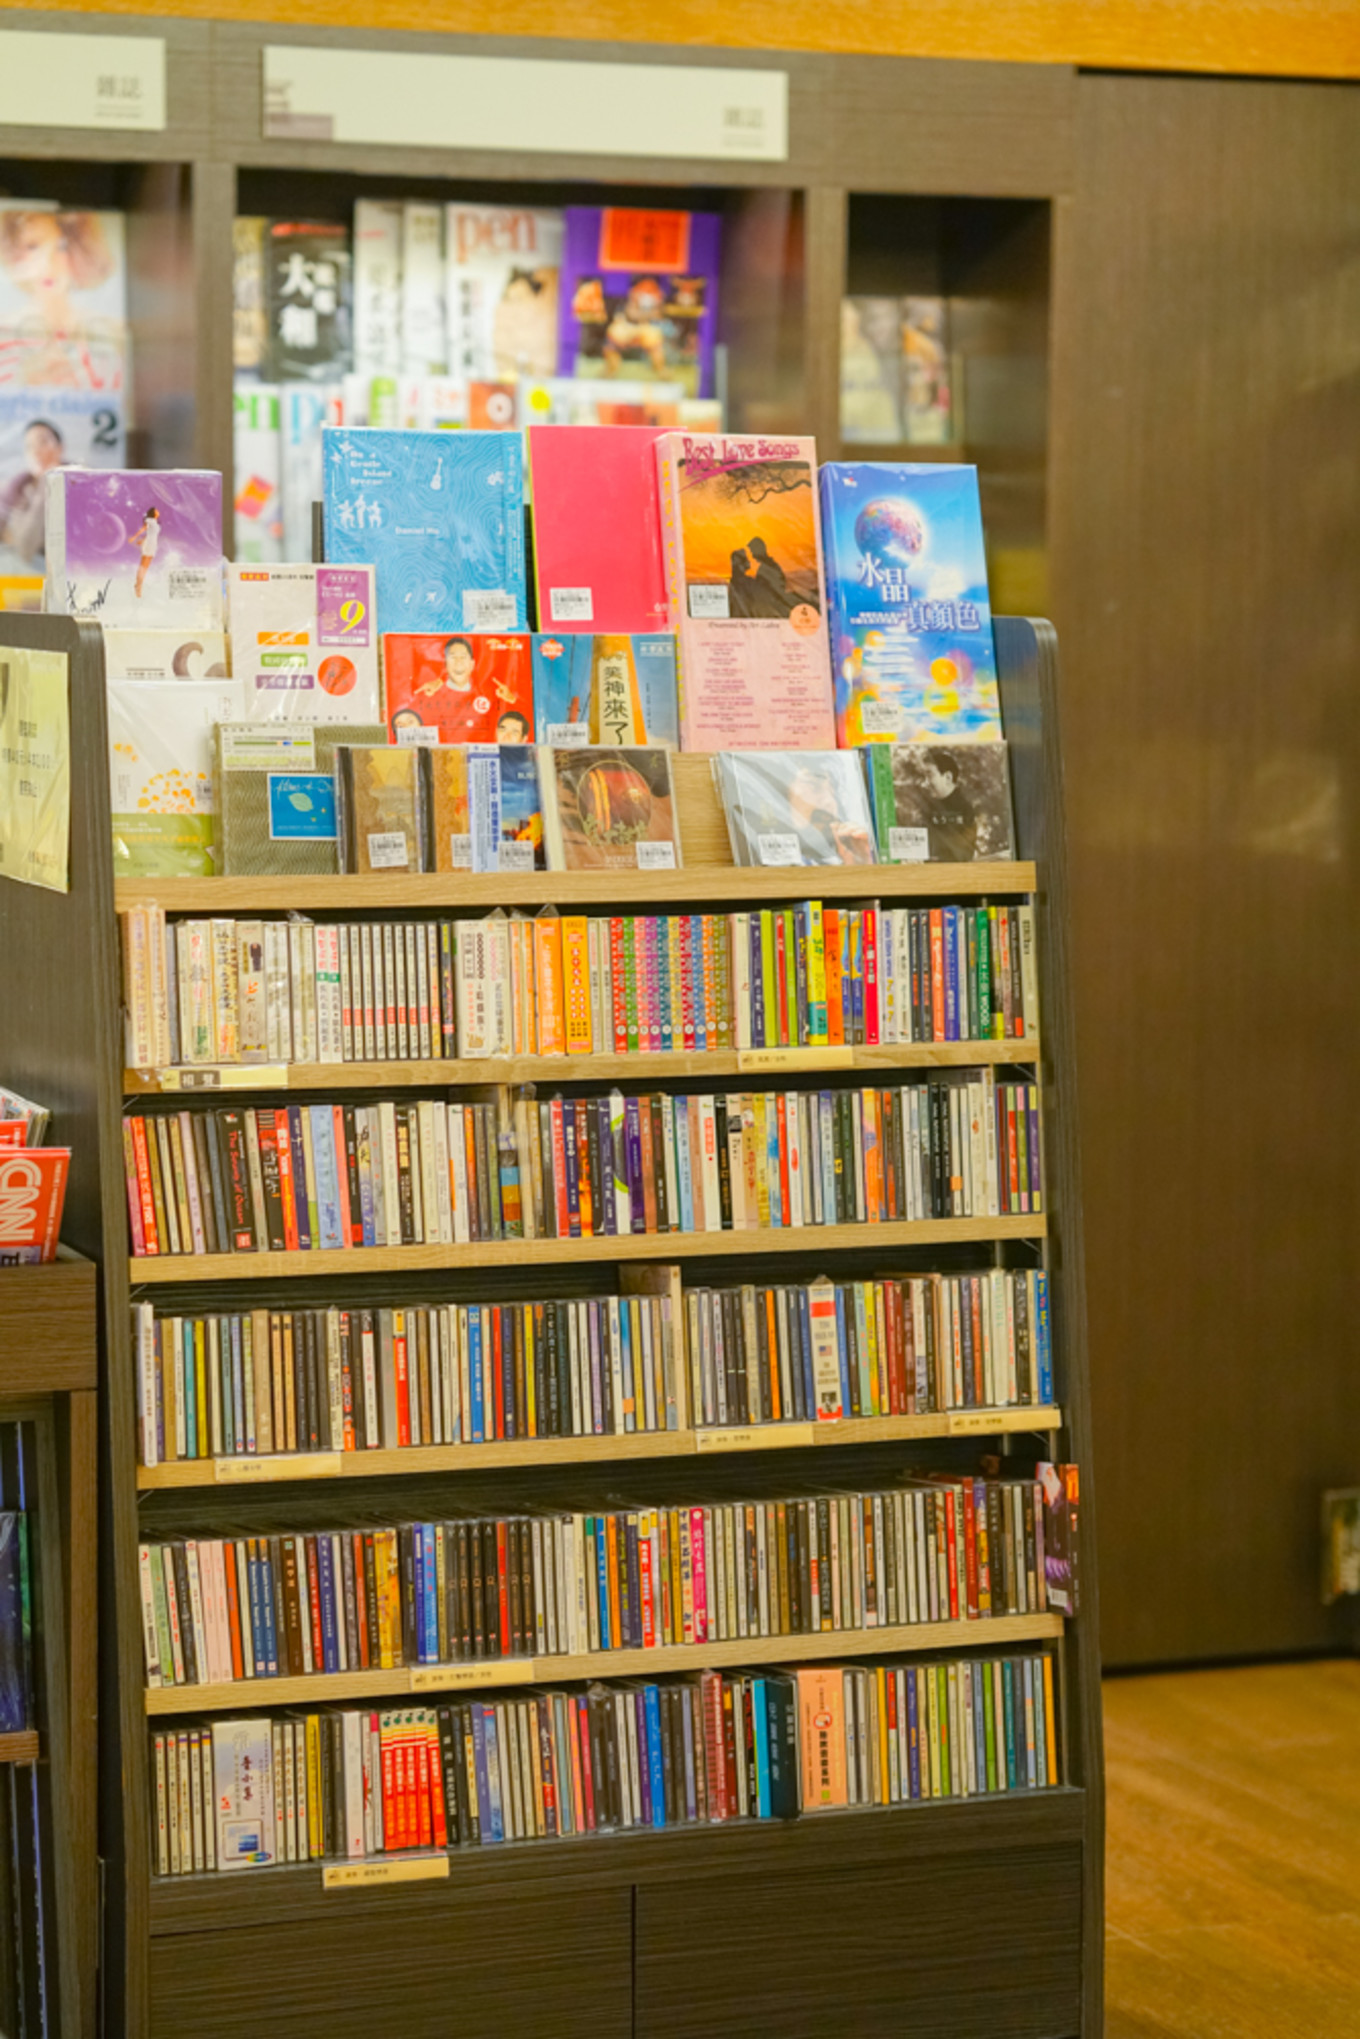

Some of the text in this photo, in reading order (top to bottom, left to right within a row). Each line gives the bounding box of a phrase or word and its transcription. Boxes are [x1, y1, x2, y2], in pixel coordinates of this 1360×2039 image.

[456, 208, 538, 264] pen
[93, 409, 118, 446] 2
[682, 437, 801, 476] Best Love Songs
[340, 599, 366, 635] 9
[603, 666, 629, 745] 笑神來了
